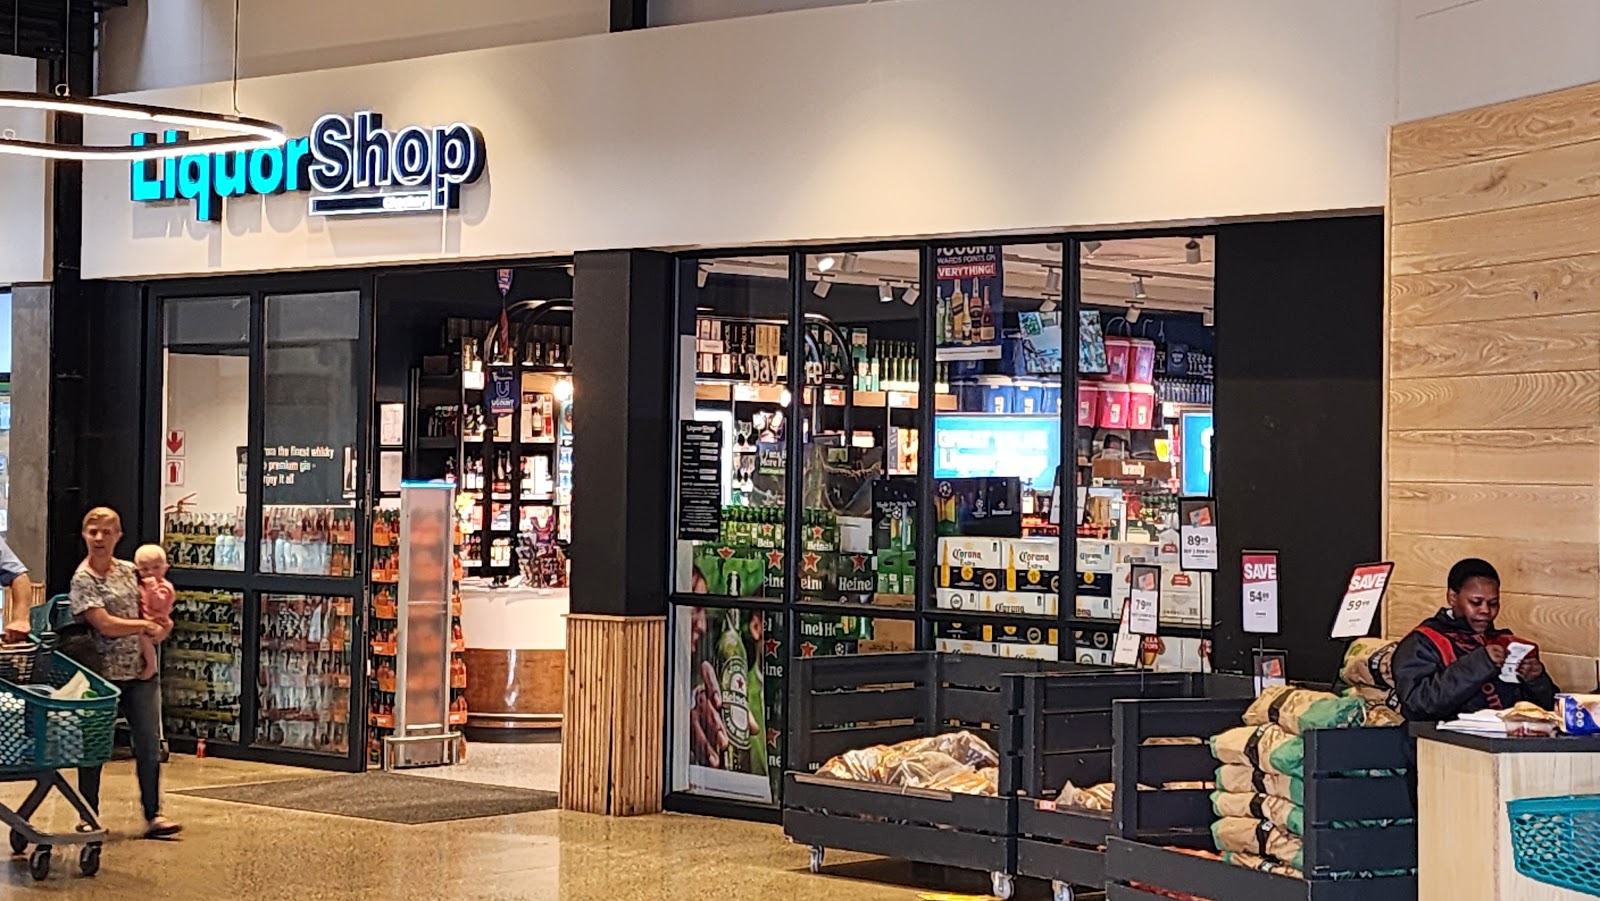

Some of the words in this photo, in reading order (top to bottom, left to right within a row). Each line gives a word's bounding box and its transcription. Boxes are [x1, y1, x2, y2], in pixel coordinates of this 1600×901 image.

[937, 256, 961, 264] WARDS
[938, 264, 994, 277] VERYTHING!
[748, 356, 778, 387] pay
[264, 447, 277, 457] rom
[311, 446, 334, 460] whisky
[269, 460, 298, 472] premium
[263, 473, 277, 487] njoy
[952, 548, 982, 561] Corona
[1019, 551, 1050, 563] Corona
[1243, 563, 1277, 580] SAVE
[1348, 572, 1388, 591] SAVE
